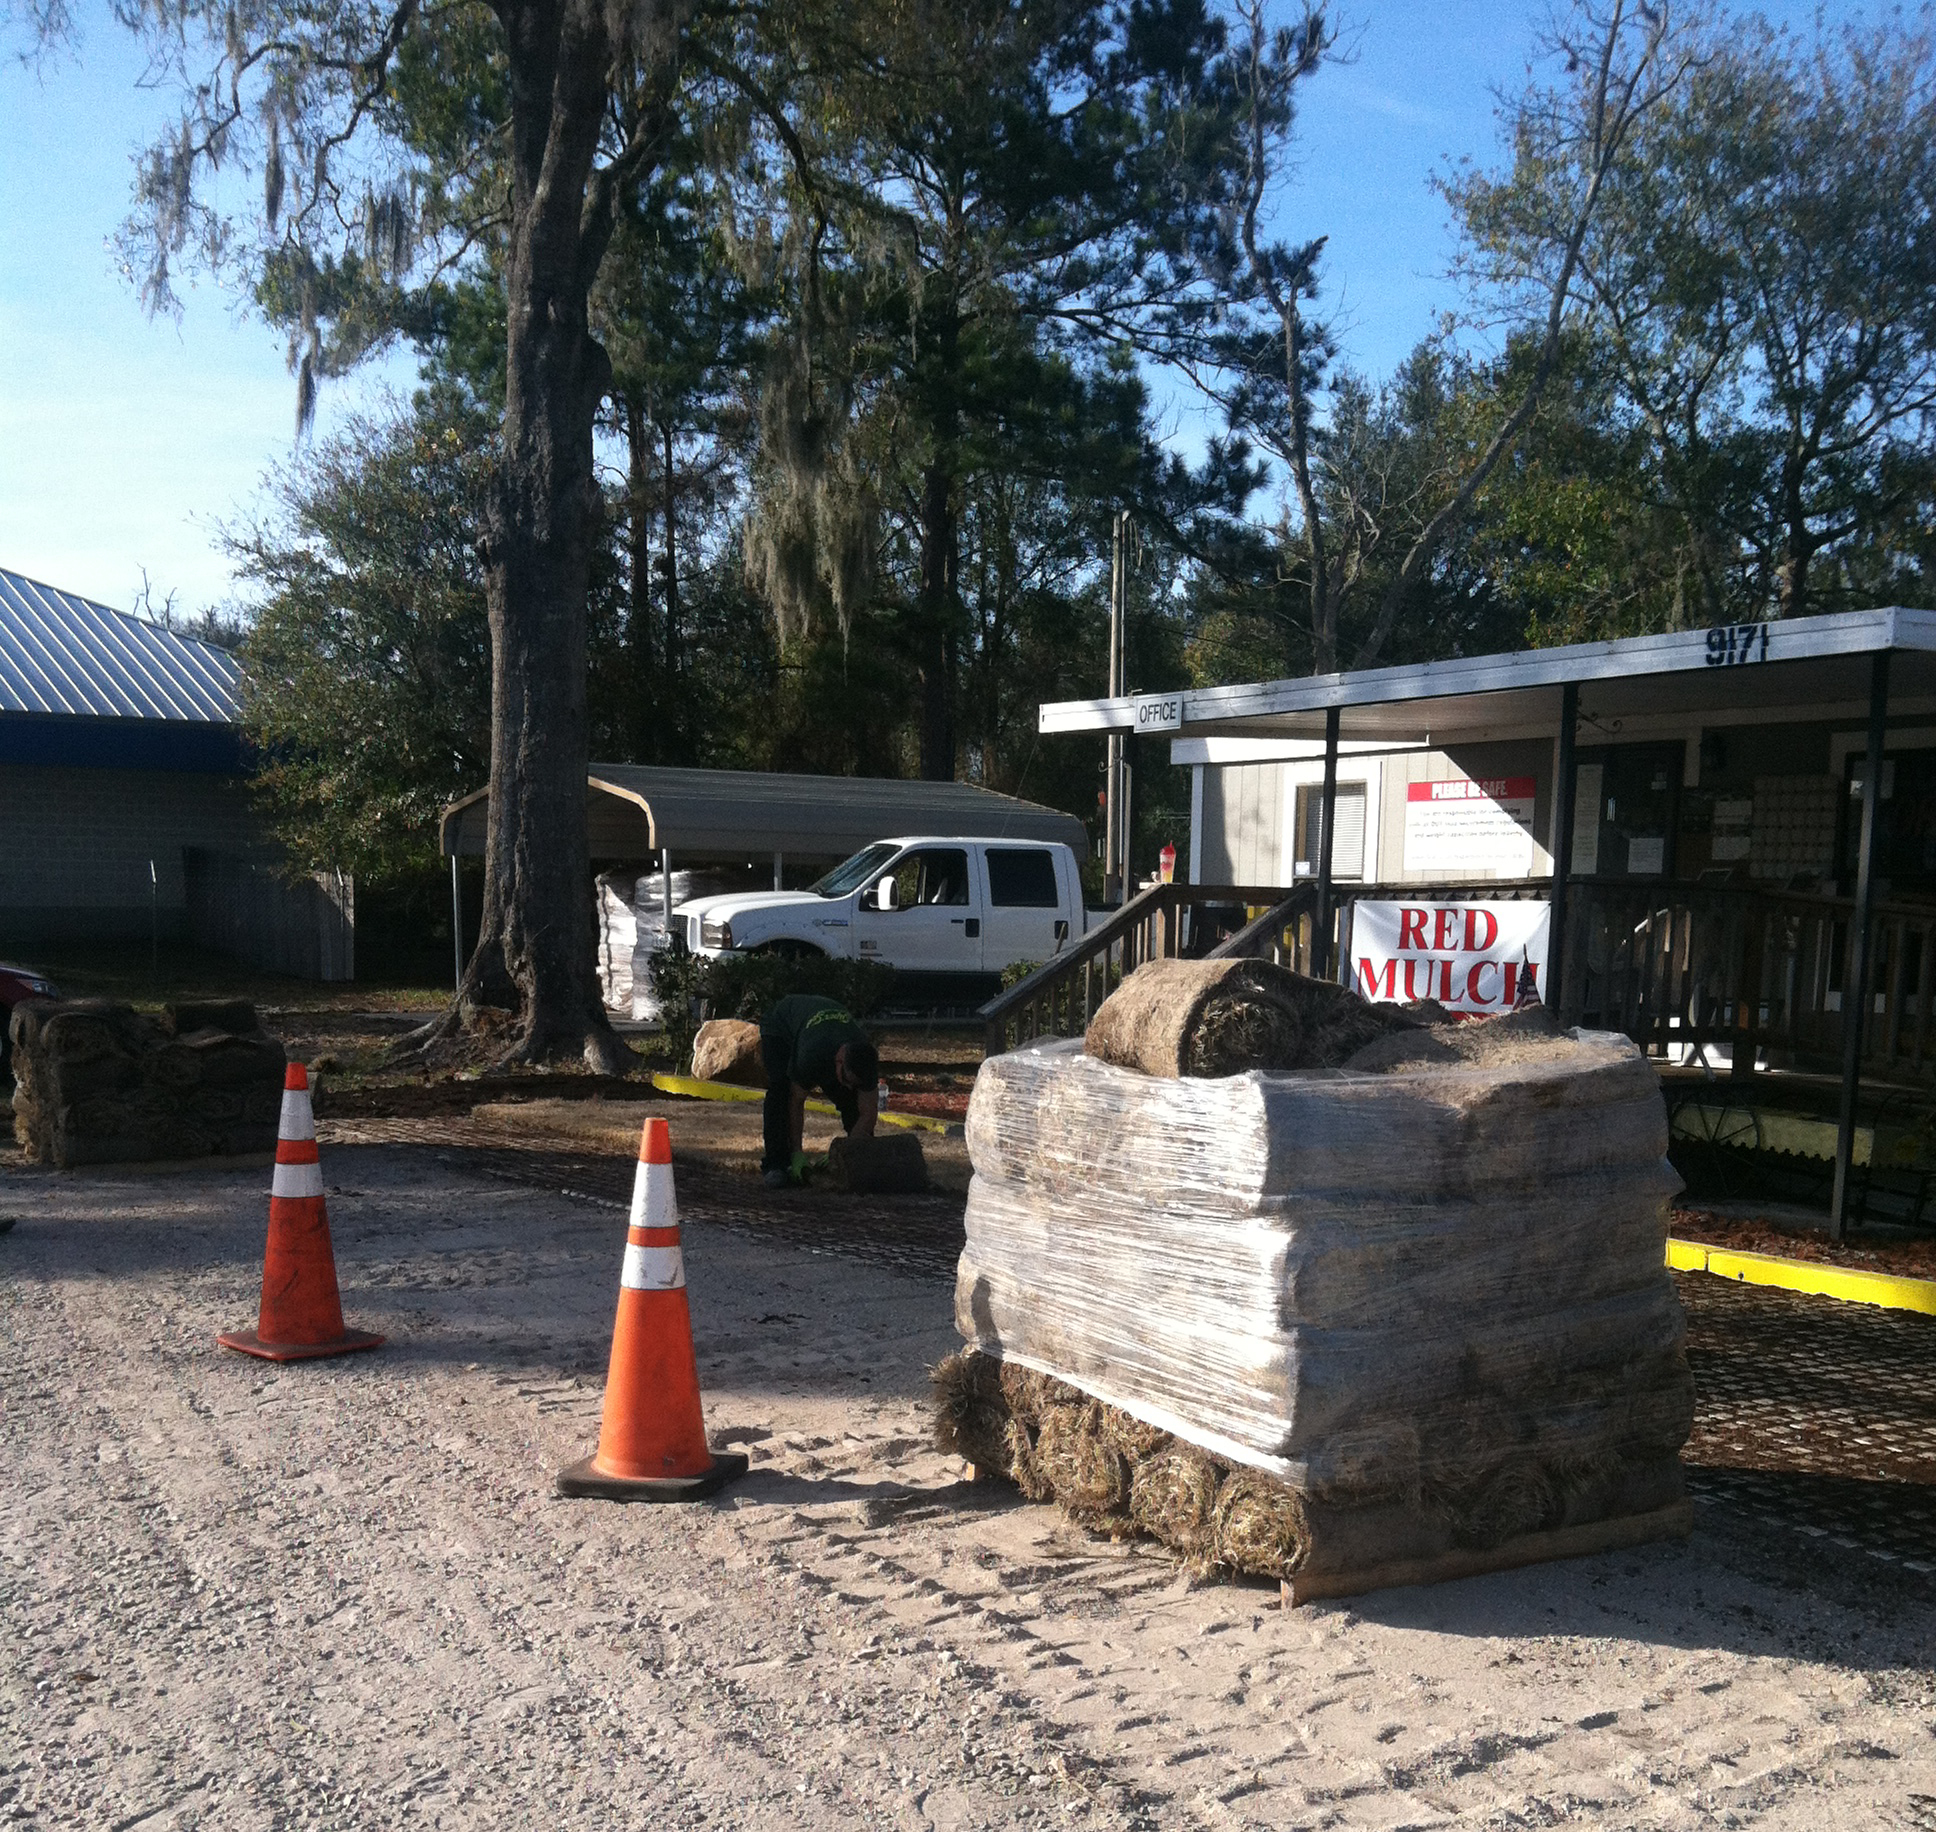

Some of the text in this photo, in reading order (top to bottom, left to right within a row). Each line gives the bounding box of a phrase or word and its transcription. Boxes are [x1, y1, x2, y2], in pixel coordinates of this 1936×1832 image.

[1705, 623, 1769, 665] 9171
[1139, 702, 1177, 724] OFFICE
[1431, 781, 1467, 799] PLEASE
[1397, 907, 1499, 952] RED
[1357, 957, 1541, 1006] MULCH
